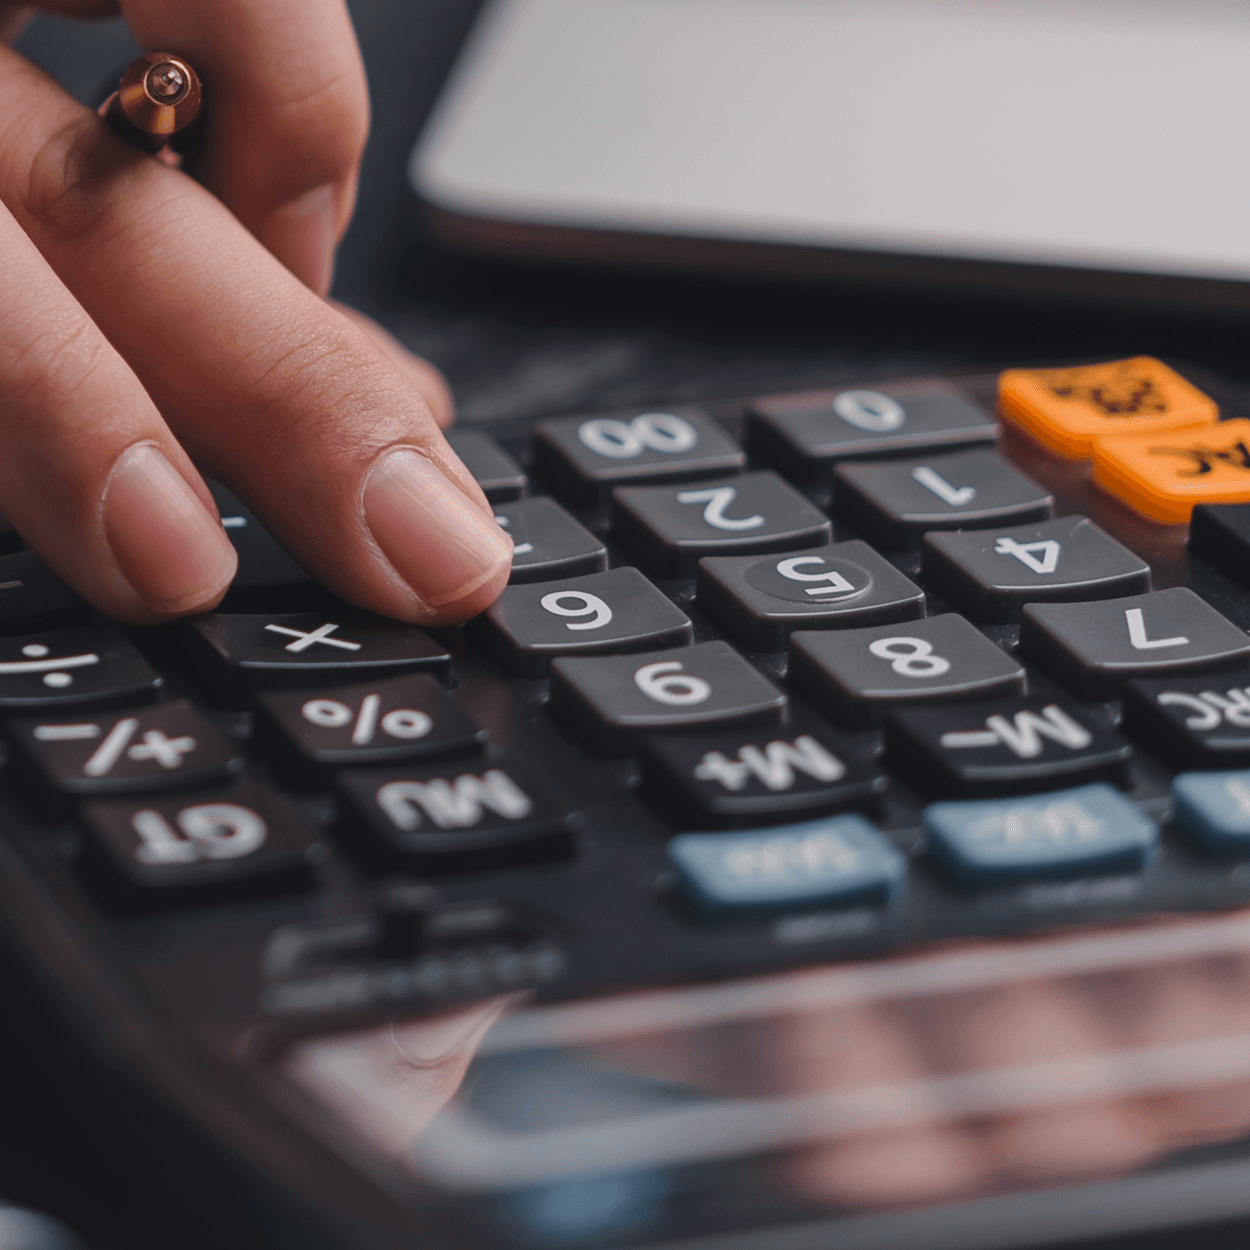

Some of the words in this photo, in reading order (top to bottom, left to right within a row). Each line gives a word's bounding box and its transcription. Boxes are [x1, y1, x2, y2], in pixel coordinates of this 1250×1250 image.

[833, 389, 906, 432] 0
[577, 413, 698, 459] 00
[912, 466, 976, 506] 1
[676, 487, 766, 530] 2
[776, 556, 855, 596] 5
[995, 537, 1061, 574] 4
[540, 590, 613, 631] 6
[1125, 608, 1190, 650] 7
[869, 637, 950, 677] 8
[634, 662, 711, 706] 9
[302, 693, 433, 745] %
[1157, 687, 1250, 730] RC
[940, 705, 1092, 758] M-
[694, 735, 846, 791] M+
[377, 769, 532, 832] MU
[133, 803, 268, 864] GT
